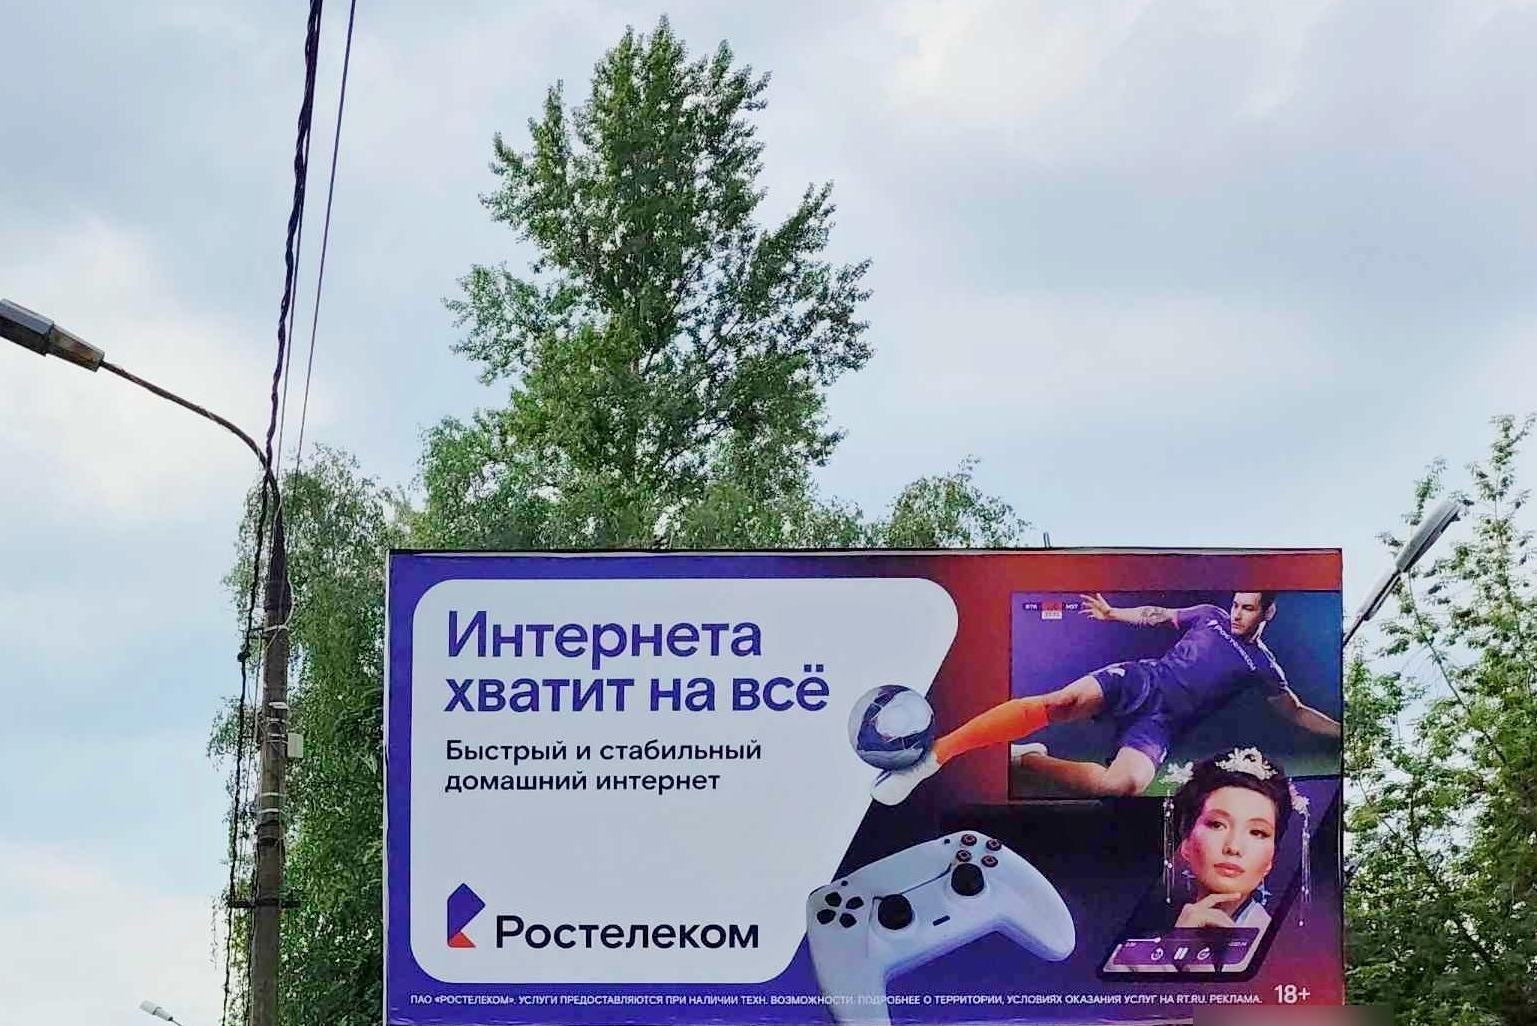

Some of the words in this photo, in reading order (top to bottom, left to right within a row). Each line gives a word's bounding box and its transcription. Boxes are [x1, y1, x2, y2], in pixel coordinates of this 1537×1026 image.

[447, 610, 762, 670] Интернета
[443, 677, 635, 712] хватит
[649, 677, 716, 712] на
[731, 664, 830, 712] всё
[446, 739, 567, 766] Быстрый
[576, 744, 591, 760] и
[599, 739, 762, 760] стабильный
[444, 771, 588, 793] домашний
[595, 772, 720, 795] интернет
[495, 915, 759, 949] Ростелеком
[410, 995, 432, 1005] ПАО
[518, 995, 558, 1005] УСЛУГИ
[560, 995, 663, 1005] ПРЕДОСТАВЛЯЮТСЯ
[665, 995, 687, 1005] ПРИ
[689, 995, 738, 1005] НАЛИЧИИ
[741, 995, 768, 1005] ТЕХН.
[923, 995, 932, 1005] О
[934, 995, 1005, 1005] ТЕРРИТОРИИ,
[1006, 995, 1062, 1005] УСЛОВИЯХ
[1064, 995, 1122, 1005] ОКАЗАНИЯ
[1124, 995, 1158, 1005] УСЛУГ
[1159, 995, 1175, 1005] НА
[1273, 984, 1310, 1003] 18+
